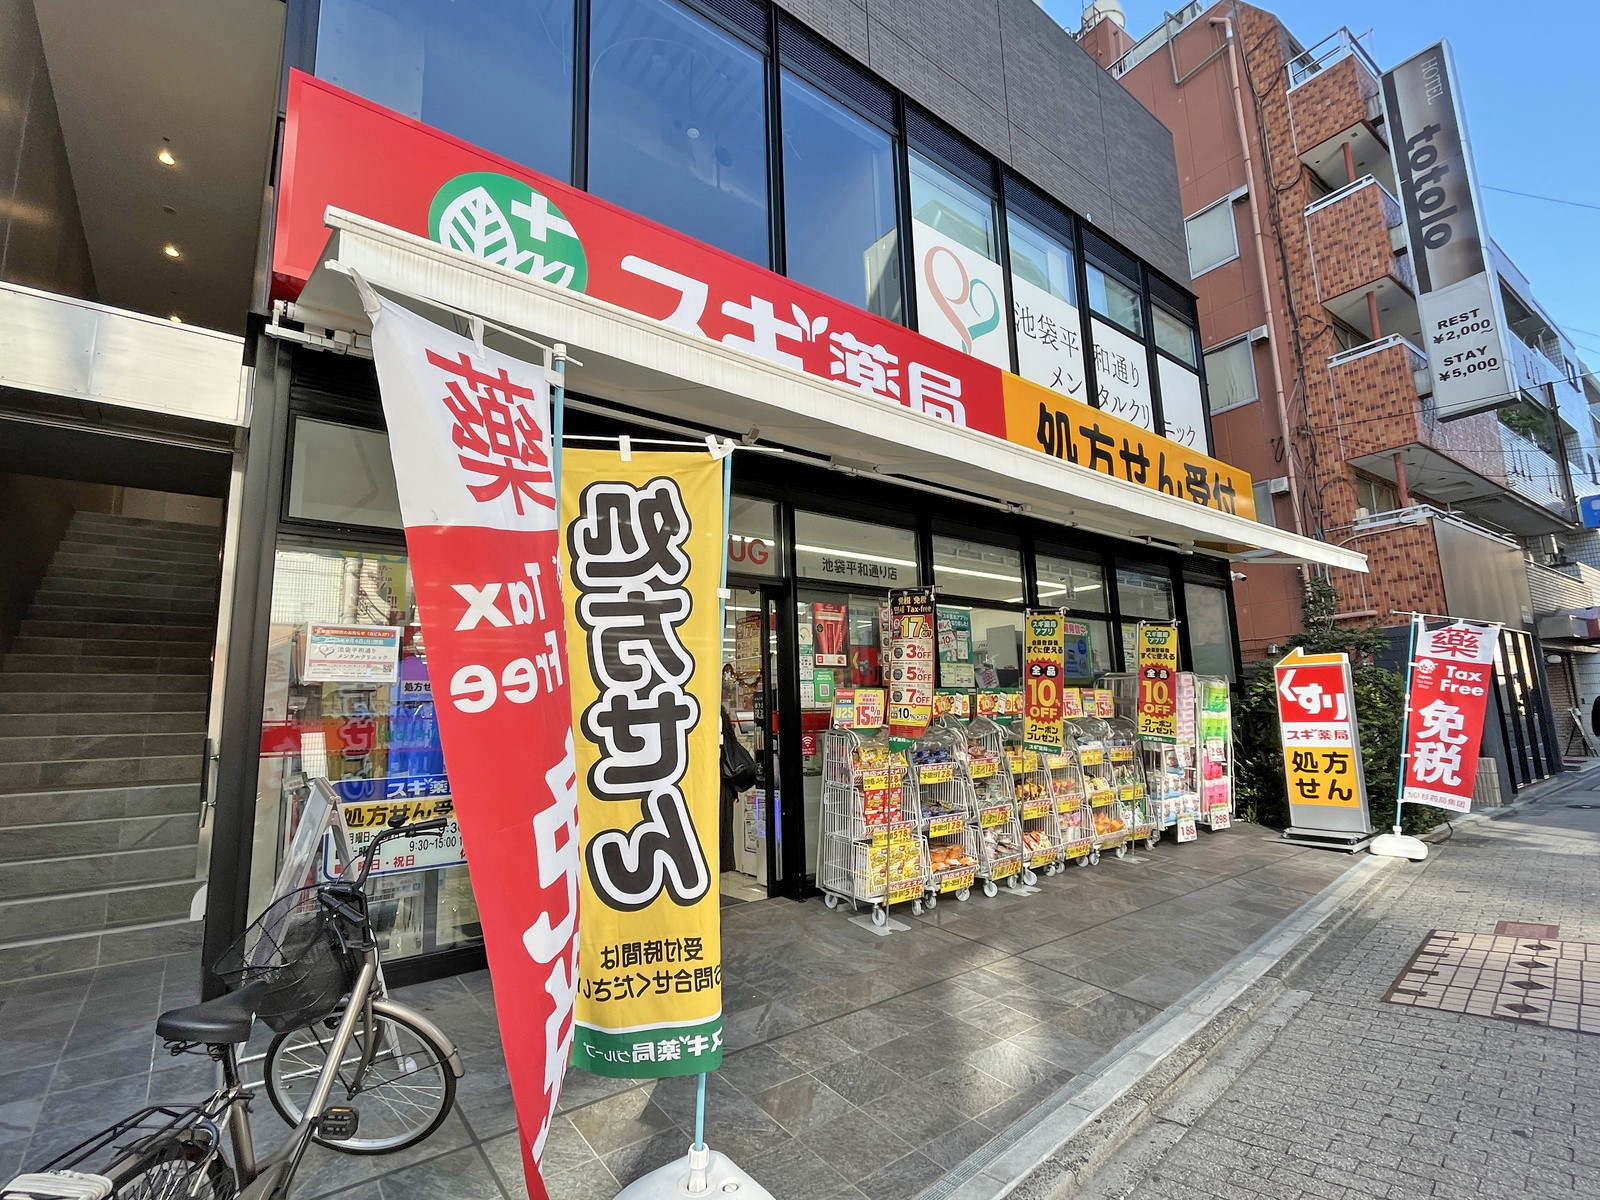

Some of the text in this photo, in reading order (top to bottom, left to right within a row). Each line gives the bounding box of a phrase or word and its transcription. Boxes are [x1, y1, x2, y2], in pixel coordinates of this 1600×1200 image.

[1420, 56, 1444, 106] HOTEL
[1407, 122, 1458, 250] totolo
[1437, 308, 1480, 330] REST
[1013, 301, 1141, 388] 池袋平和通り
[1443, 345, 1488, 366] STAY
[1050, 366, 1197, 448] メンタルクリニック
[822, 557, 898, 581] 池袋平和通り店
[1035, 627, 1053, 635] アプリ
[1027, 646, 1064, 654] すぐに使える
[1031, 664, 1057, 677] 全品
[1445, 665, 1483, 682] Tax
[1278, 668, 1349, 721] くすり
[1440, 678, 1485, 697] Free
[1029, 706, 1058, 719] OFF
[1143, 703, 1171, 714] OFF
[1030, 723, 1059, 735] クーポン
[1141, 725, 1175, 736] プレゼント
[1144, 718, 1172, 728] クーポン
[1026, 732, 1061, 744] プレゼント
[1286, 728, 1349, 741] スギ薬局
[1412, 698, 1469, 787] 免税
[1292, 750, 1350, 775] 処方
[387, 777, 452, 799] スギ薬
[1295, 778, 1353, 801] せん
[1180, 825, 1196, 837] 188
